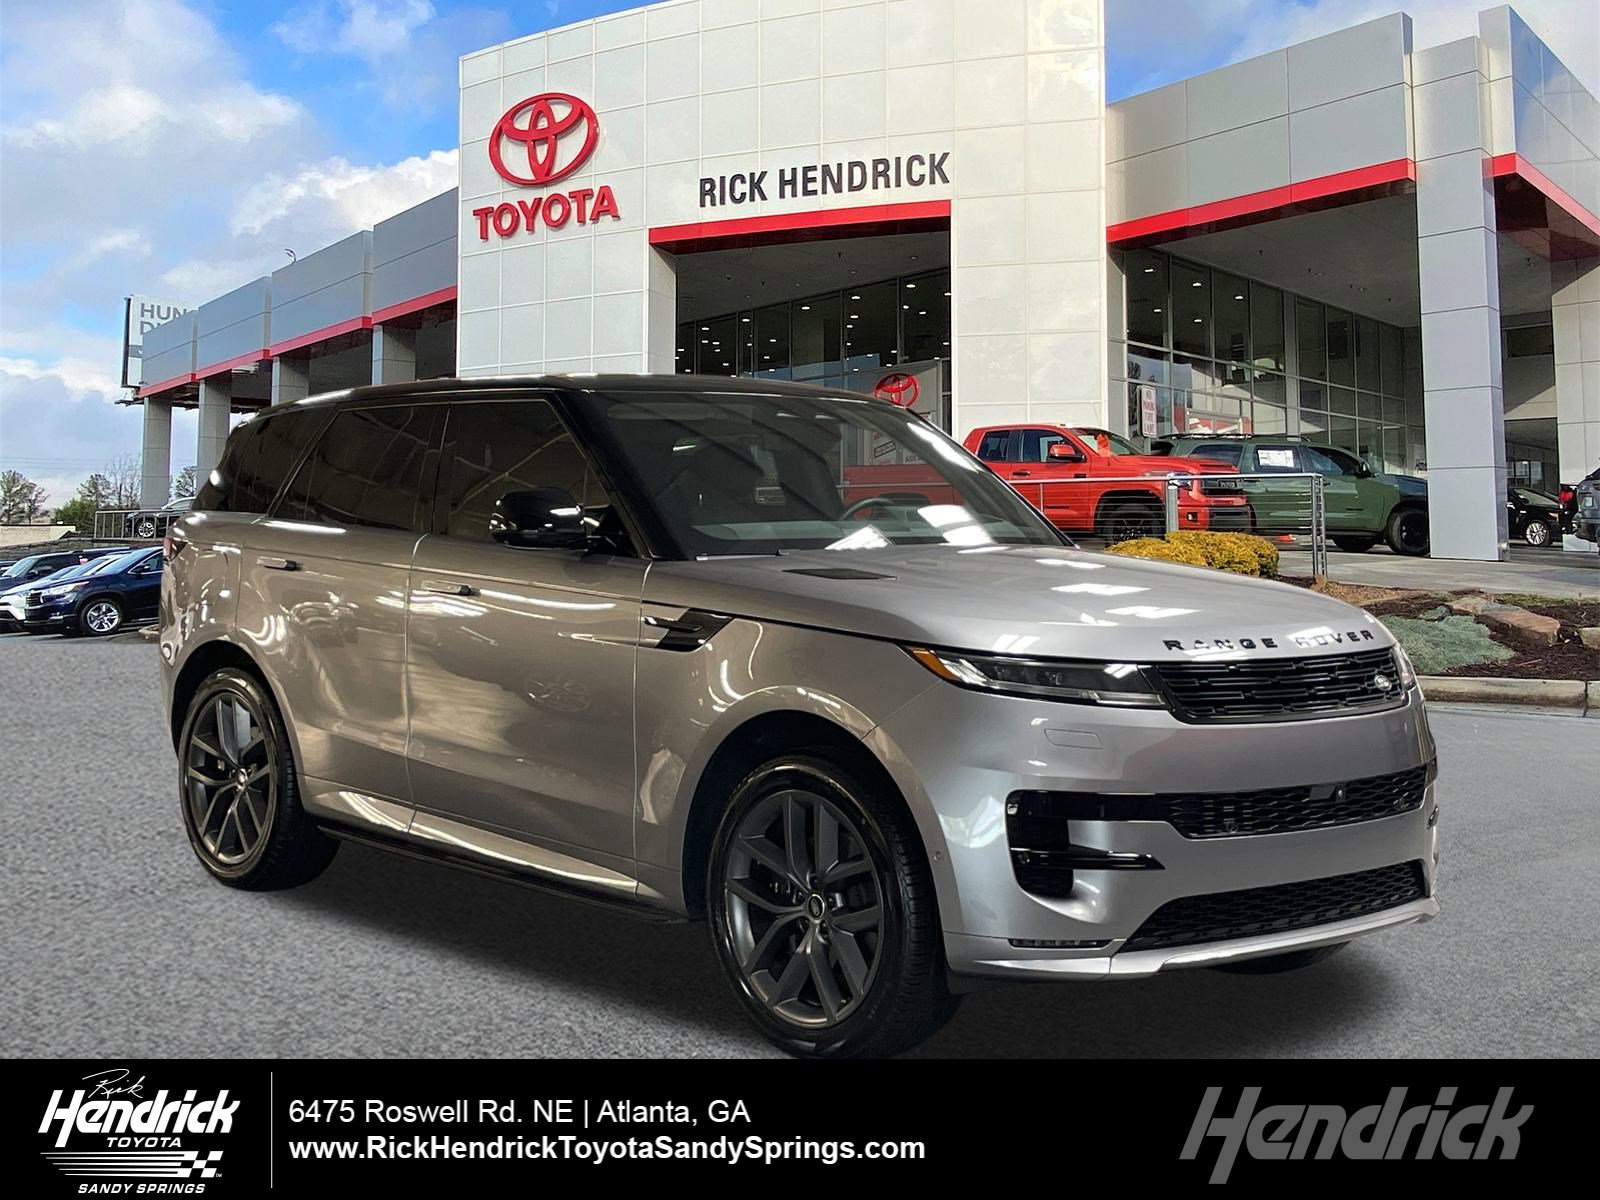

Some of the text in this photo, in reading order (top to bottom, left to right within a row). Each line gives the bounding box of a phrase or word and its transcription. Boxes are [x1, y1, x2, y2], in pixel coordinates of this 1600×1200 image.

[699, 151, 951, 208] RICK HENDRICK
[472, 185, 621, 241] TOYOTA
[1162, 629, 1375, 651] RANGE ROVER
